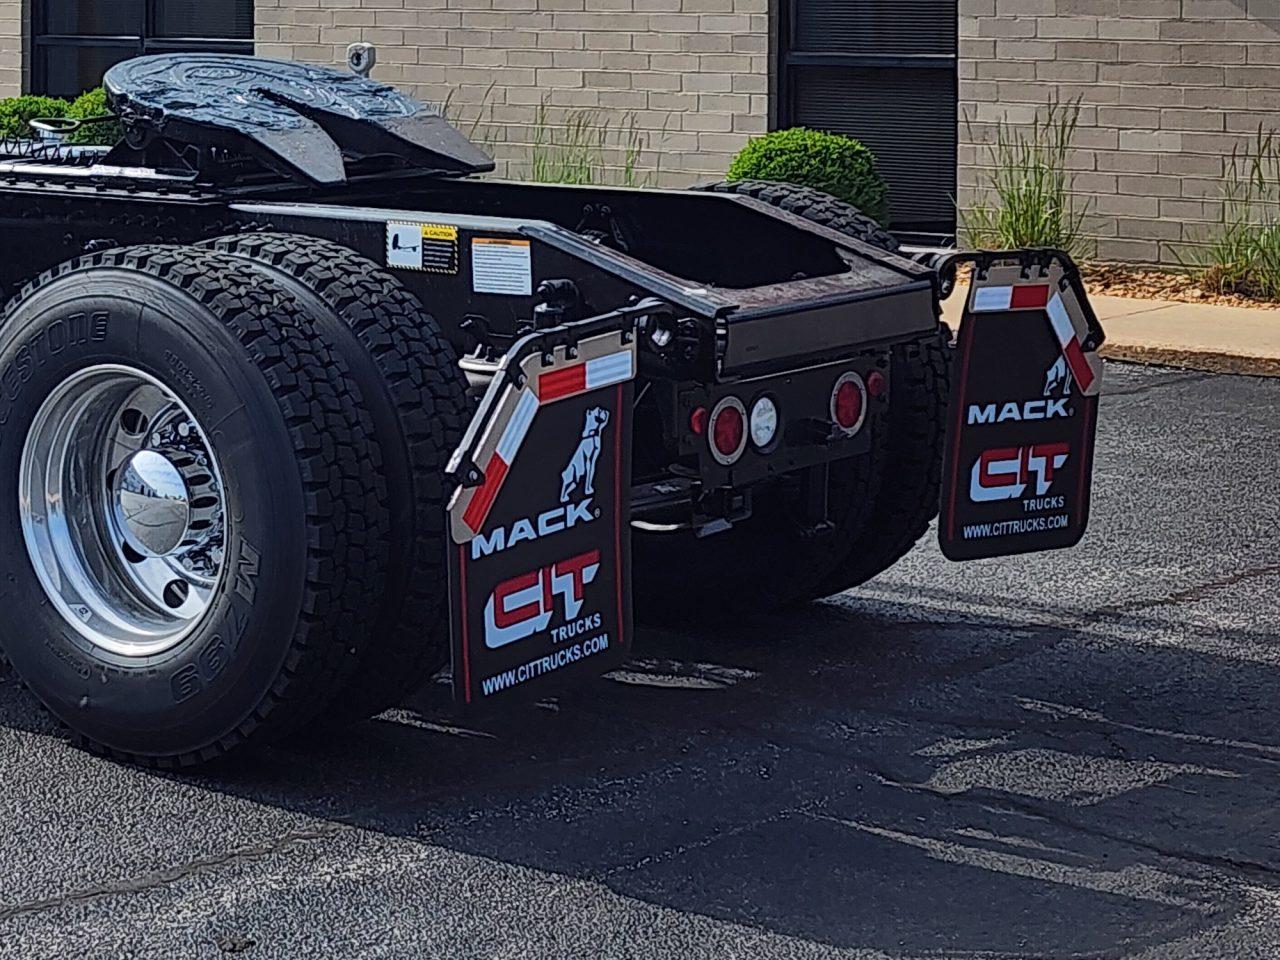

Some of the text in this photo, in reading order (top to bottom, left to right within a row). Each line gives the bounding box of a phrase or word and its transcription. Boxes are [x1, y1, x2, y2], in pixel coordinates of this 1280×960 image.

[967, 396, 1070, 426] MACK
[969, 441, 1070, 503] CIT
[963, 513, 1069, 539] WWW.CITTRUCKS.COM
[1022, 495, 1065, 513] TRUCKS
[471, 497, 595, 560] MACK
[483, 549, 601, 649] CIT
[550, 612, 602, 644] TRUCKS
[481, 633, 610, 696] WWW.CITTRUCKS.COM
